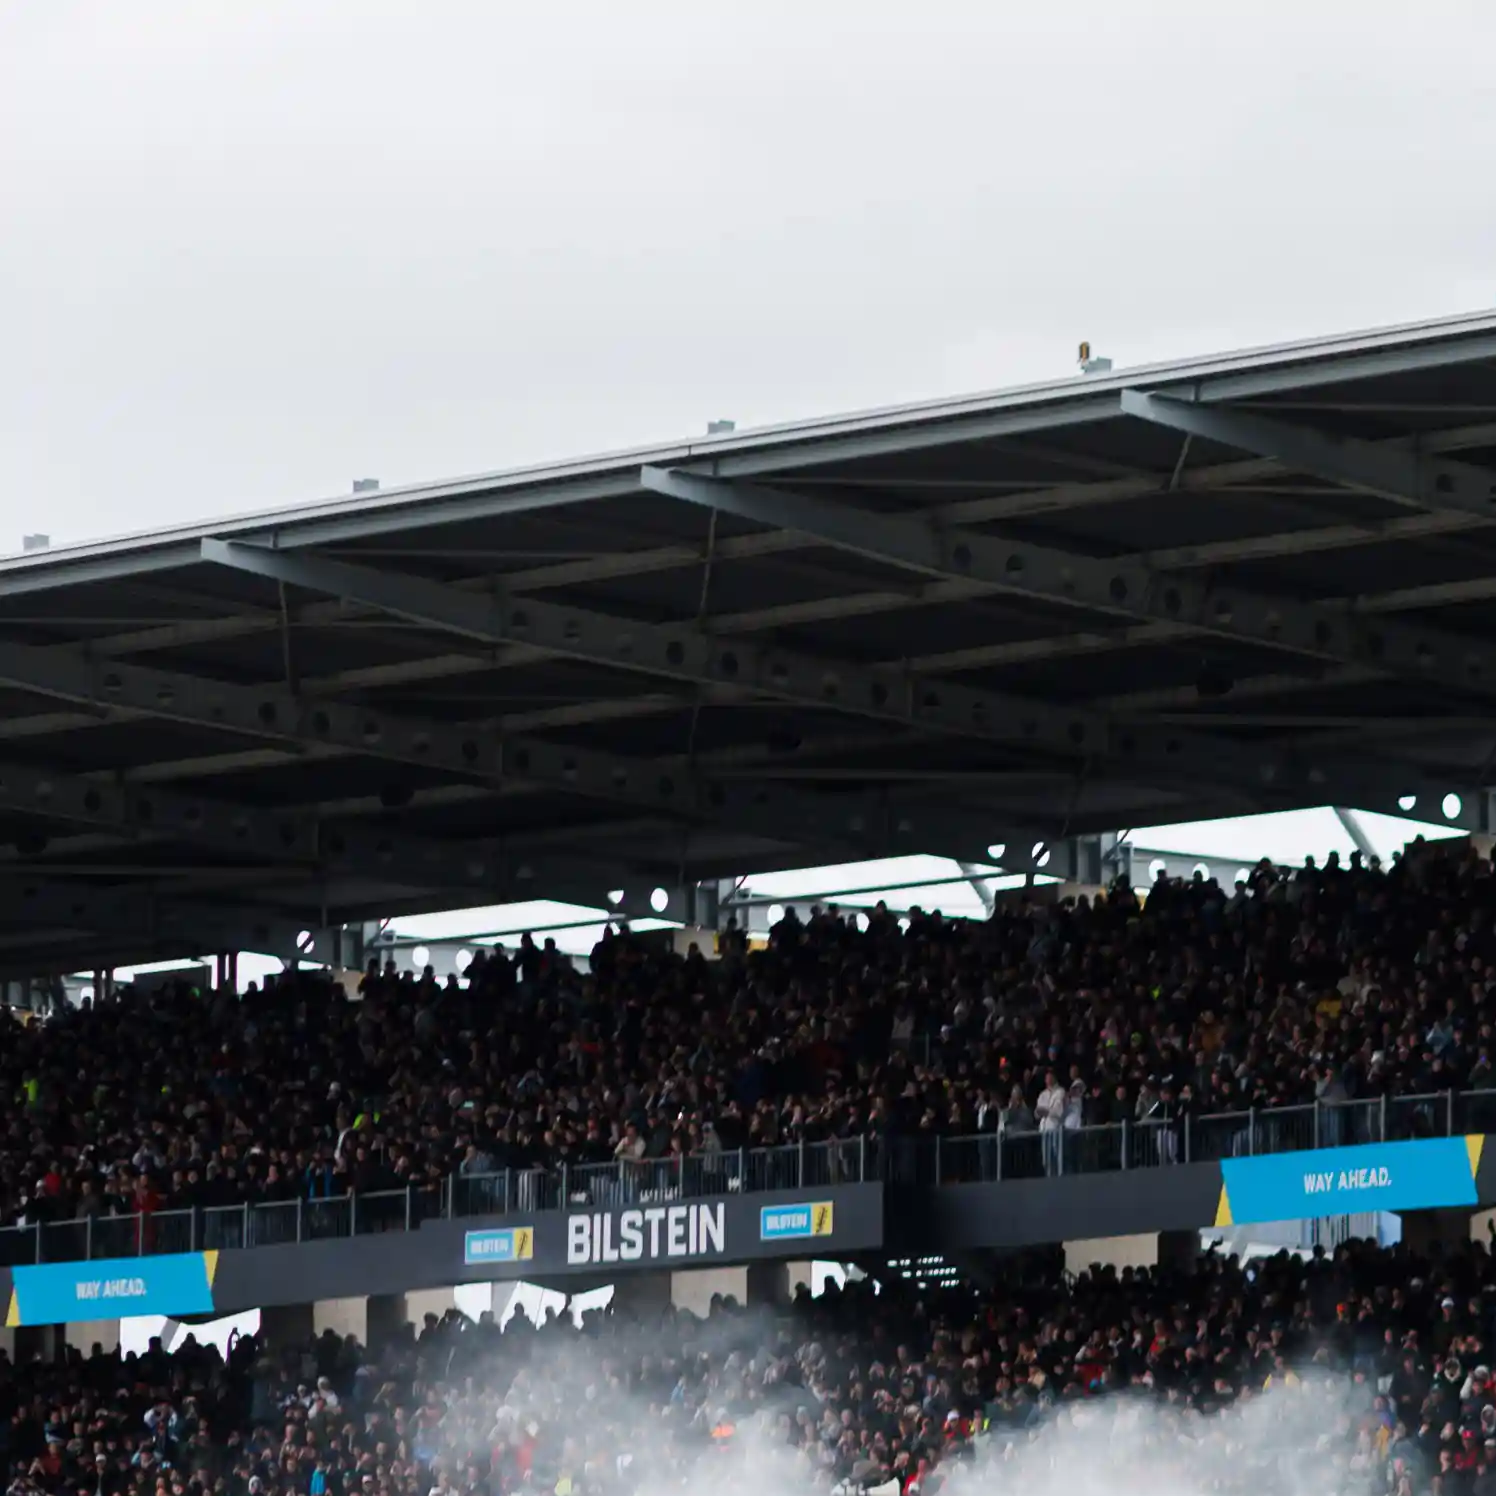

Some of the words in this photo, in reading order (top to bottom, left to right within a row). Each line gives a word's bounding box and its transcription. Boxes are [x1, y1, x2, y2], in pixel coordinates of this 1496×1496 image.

[1303, 1170, 1334, 1195] WAY
[1337, 1166, 1393, 1191] AHEAD.
[567, 1202, 726, 1265] BILSTEIN
[75, 1279, 100, 1301] WAY
